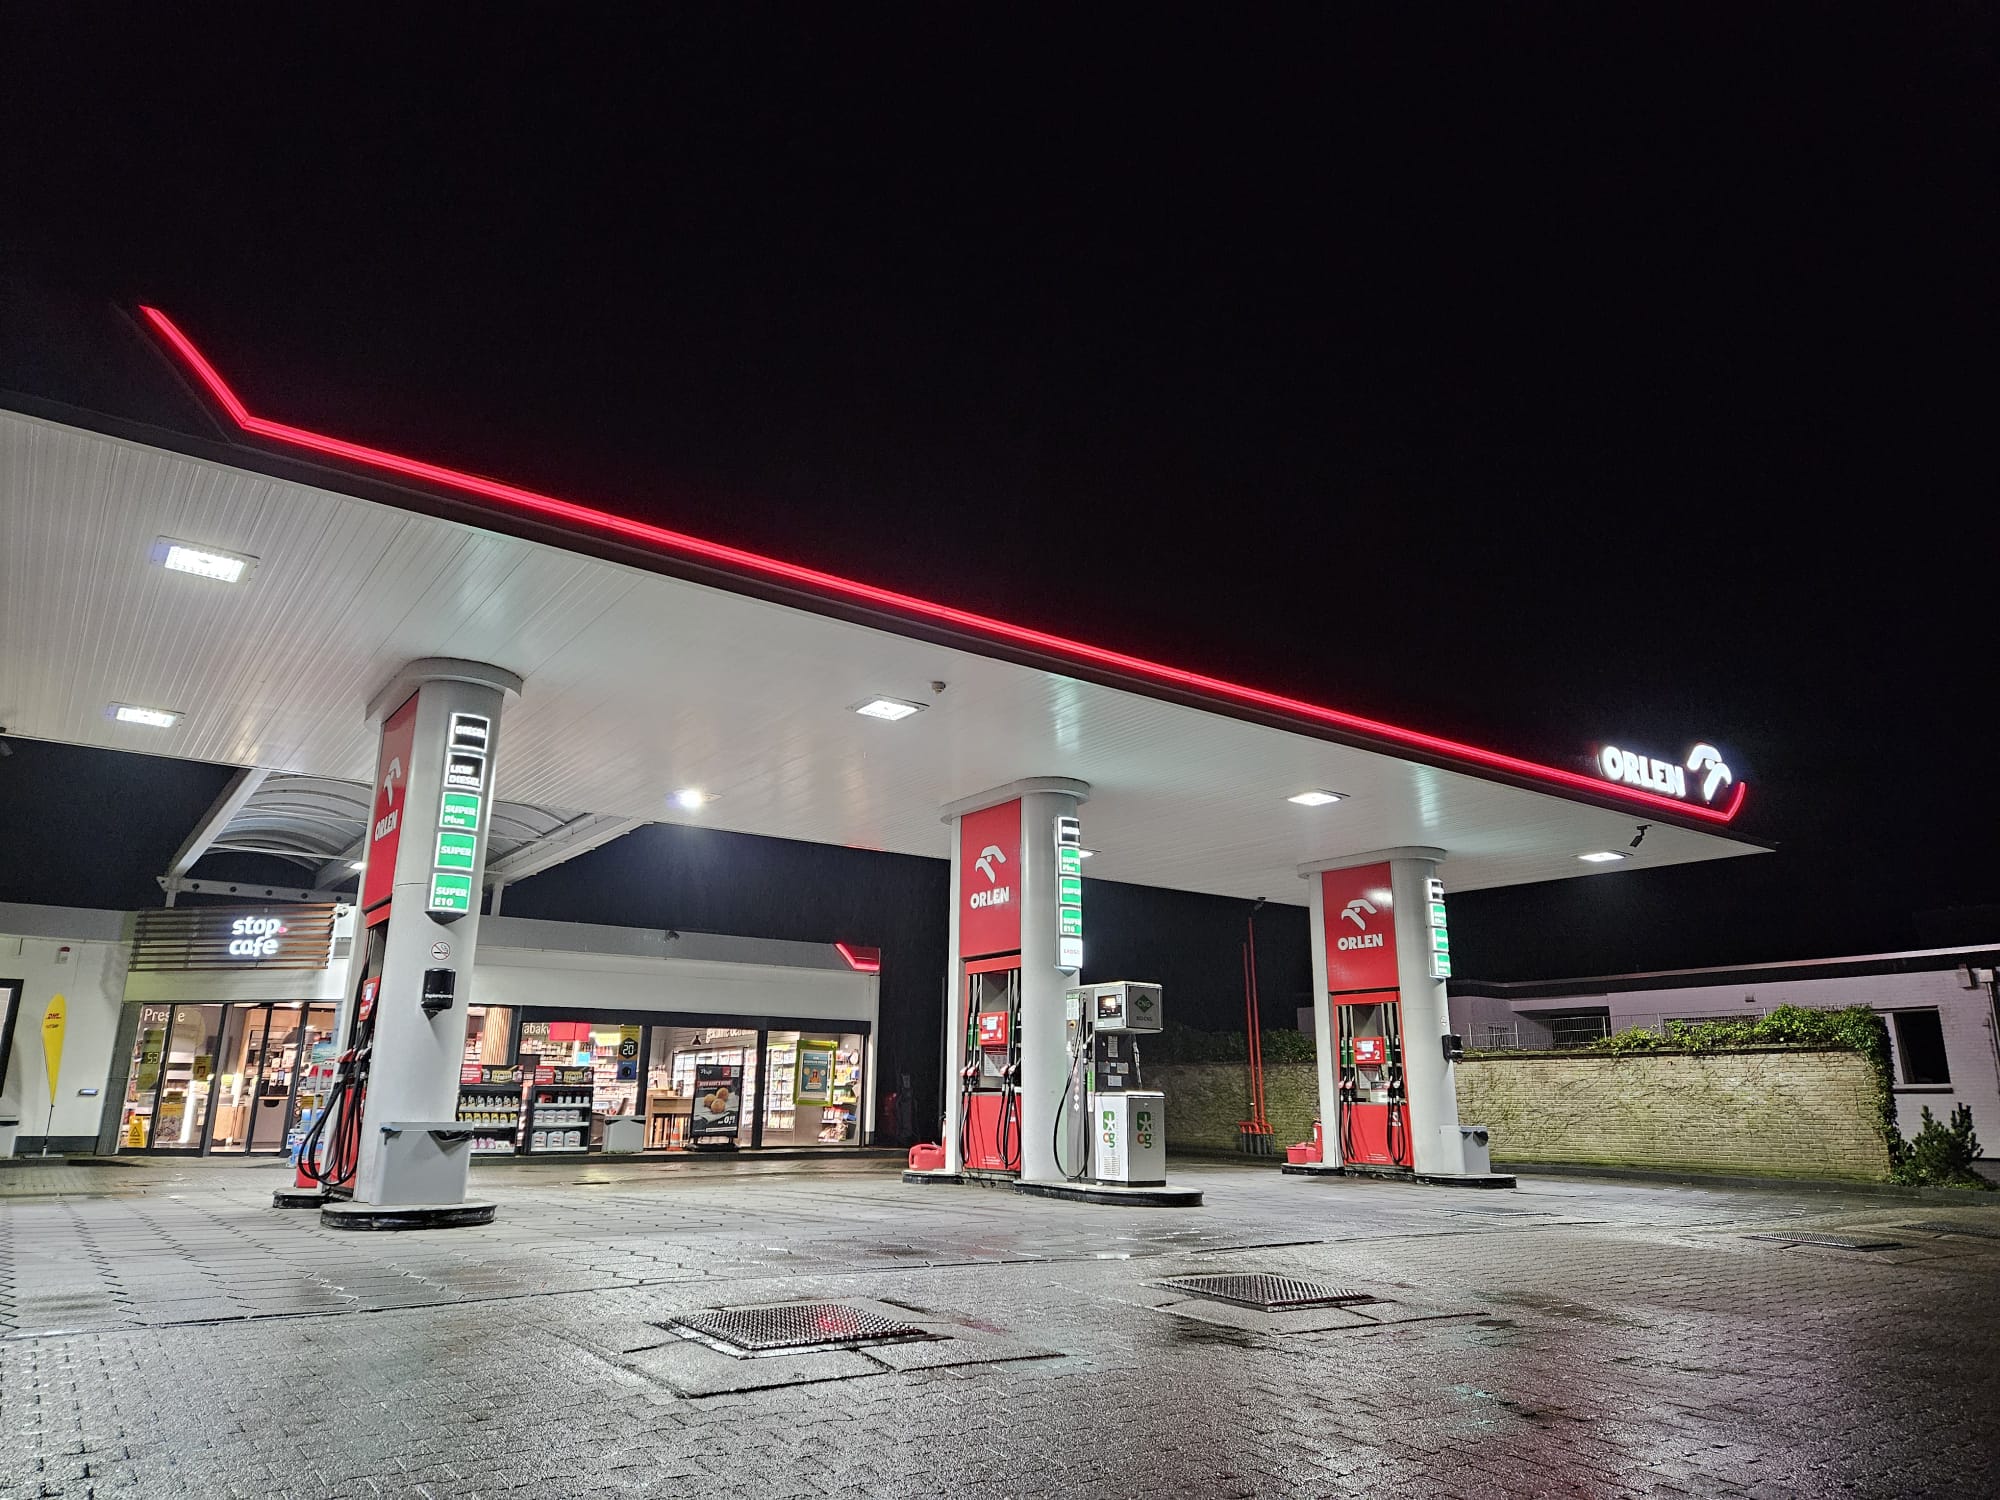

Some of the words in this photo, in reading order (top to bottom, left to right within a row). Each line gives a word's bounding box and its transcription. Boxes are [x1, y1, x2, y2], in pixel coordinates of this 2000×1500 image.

[1602, 745, 1686, 798] ORLEN
[445, 805, 476, 816] SUPER
[374, 809, 399, 842] ORLEN
[444, 816, 465, 825] Plus
[441, 846, 471, 857] SUPER
[435, 886, 467, 898] SUPER
[970, 886, 1010, 910] ORLEN
[434, 898, 454, 906] E10
[229, 936, 279, 957] cafe
[1337, 933, 1384, 951] ORLEN
[1137, 999, 1151, 1007] CNG
[143, 1008, 185, 1022] Prese
[996, 1027, 1003, 1040] 4
[622, 1044, 635, 1056] 20
[1374, 1049, 1381, 1060] 2
[147, 1052, 160, 1064] 53
